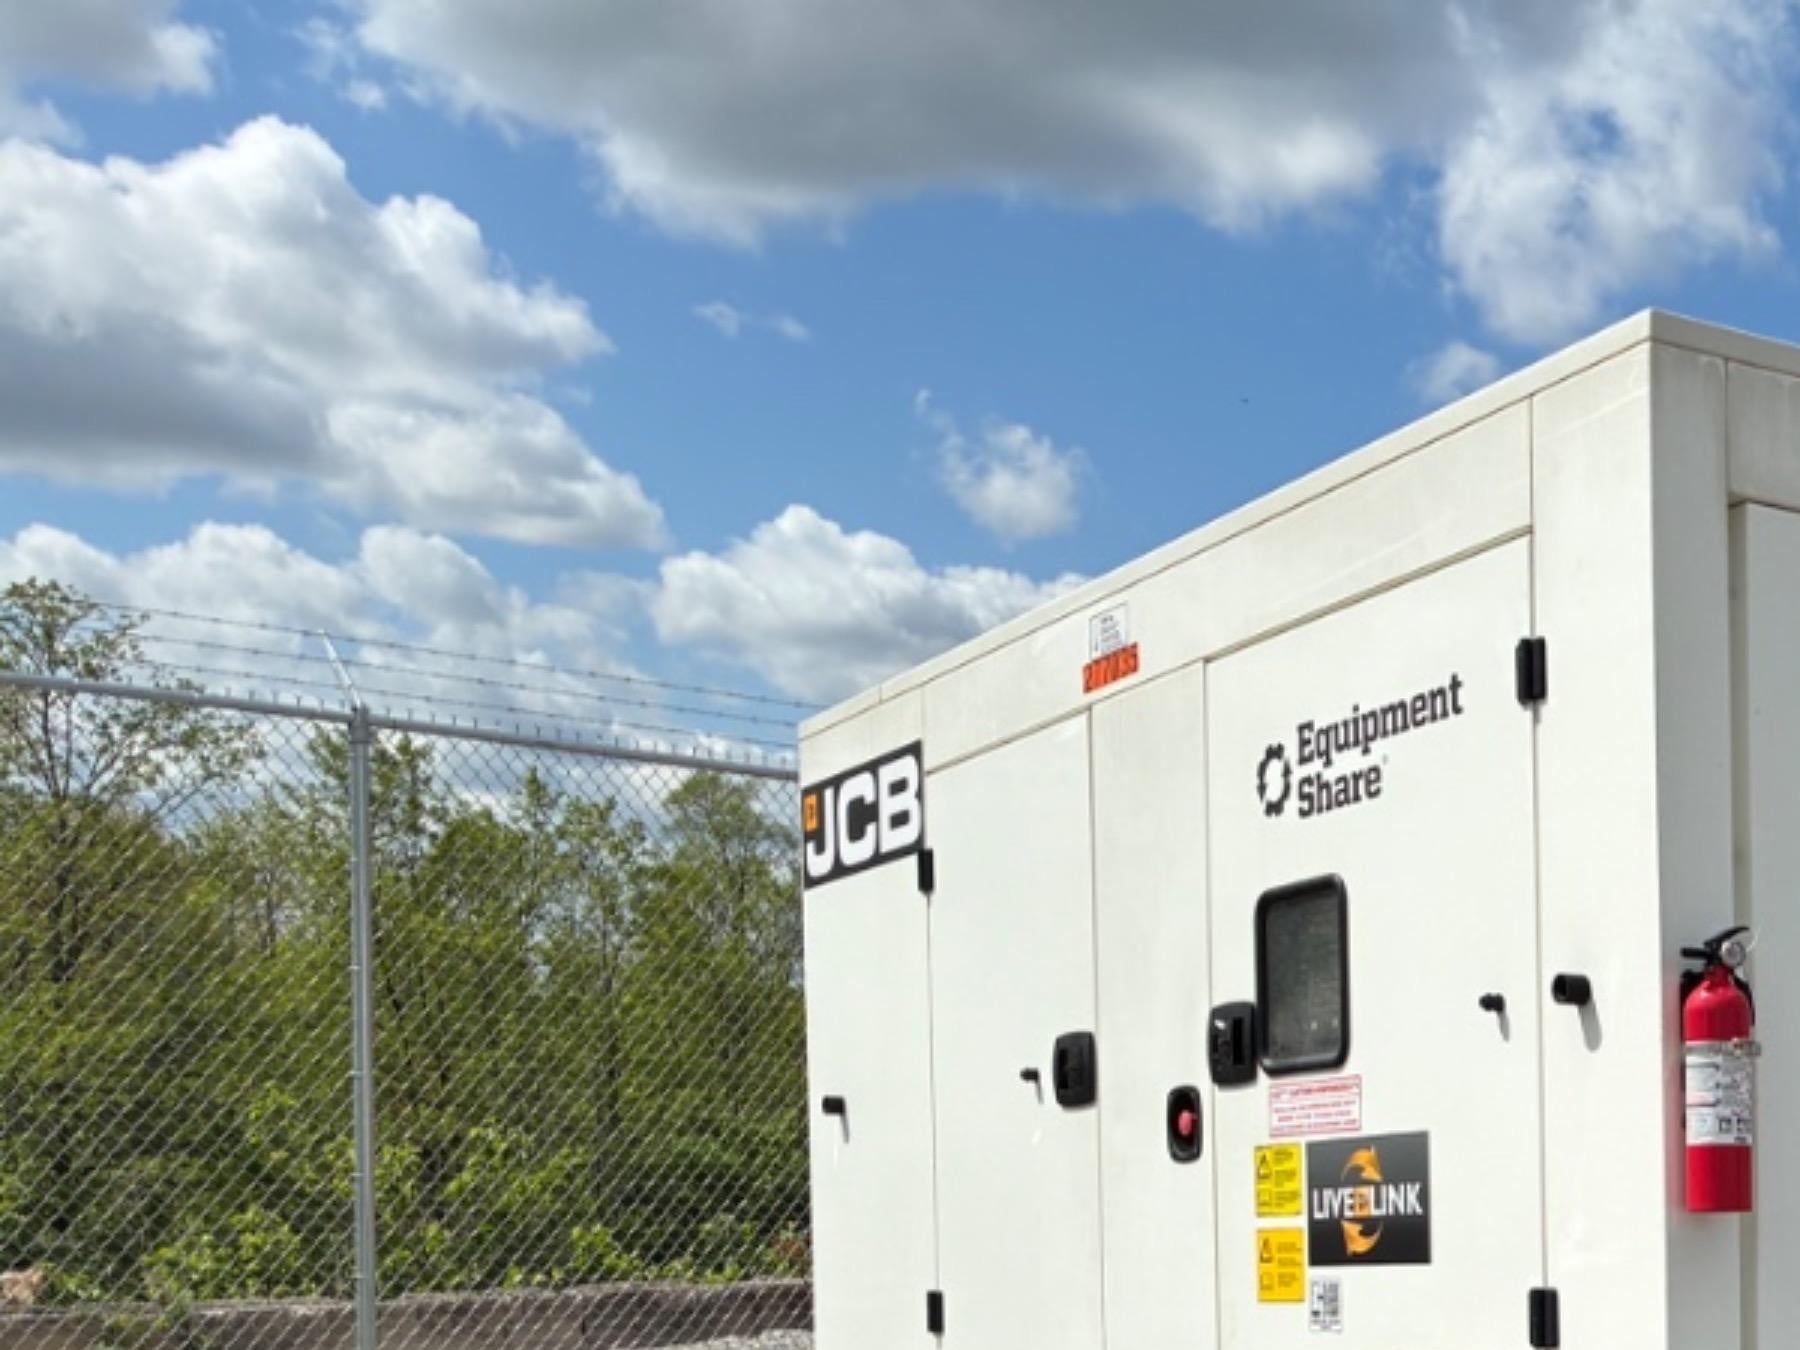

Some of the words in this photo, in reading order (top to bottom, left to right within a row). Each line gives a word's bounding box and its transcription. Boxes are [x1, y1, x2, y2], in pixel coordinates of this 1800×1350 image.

[1296, 672, 1463, 768] Equipment
[805, 754, 922, 877] JCB
[1298, 764, 1381, 819] Share
[1313, 1186, 1355, 1219] LIVE
[1370, 1181, 1424, 1216] LINK
